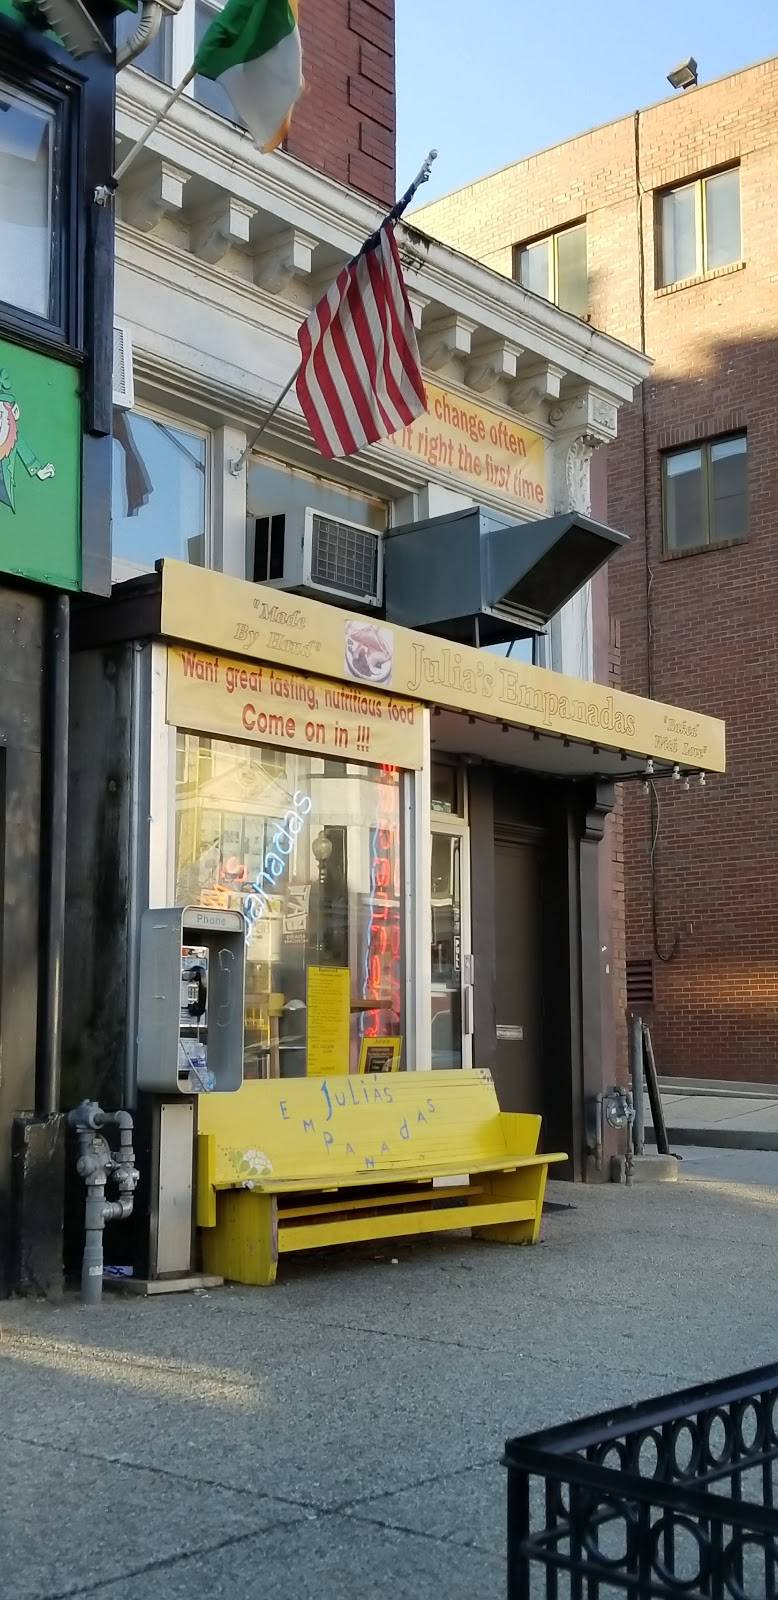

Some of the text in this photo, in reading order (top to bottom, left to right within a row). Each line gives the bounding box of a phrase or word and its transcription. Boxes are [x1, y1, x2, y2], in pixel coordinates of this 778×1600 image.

[434, 394, 486, 443] change
[490, 421, 527, 457] often
[402, 425, 544, 504] it right the first time
[233, 622, 260, 650] By
[181, 650, 415, 725] Want great tasting, nutritious food
[407, 642, 636, 737] Julia's Empanadas
[241, 703, 371, 752] Come on in !!!
[197, 913, 226, 925] Phone
